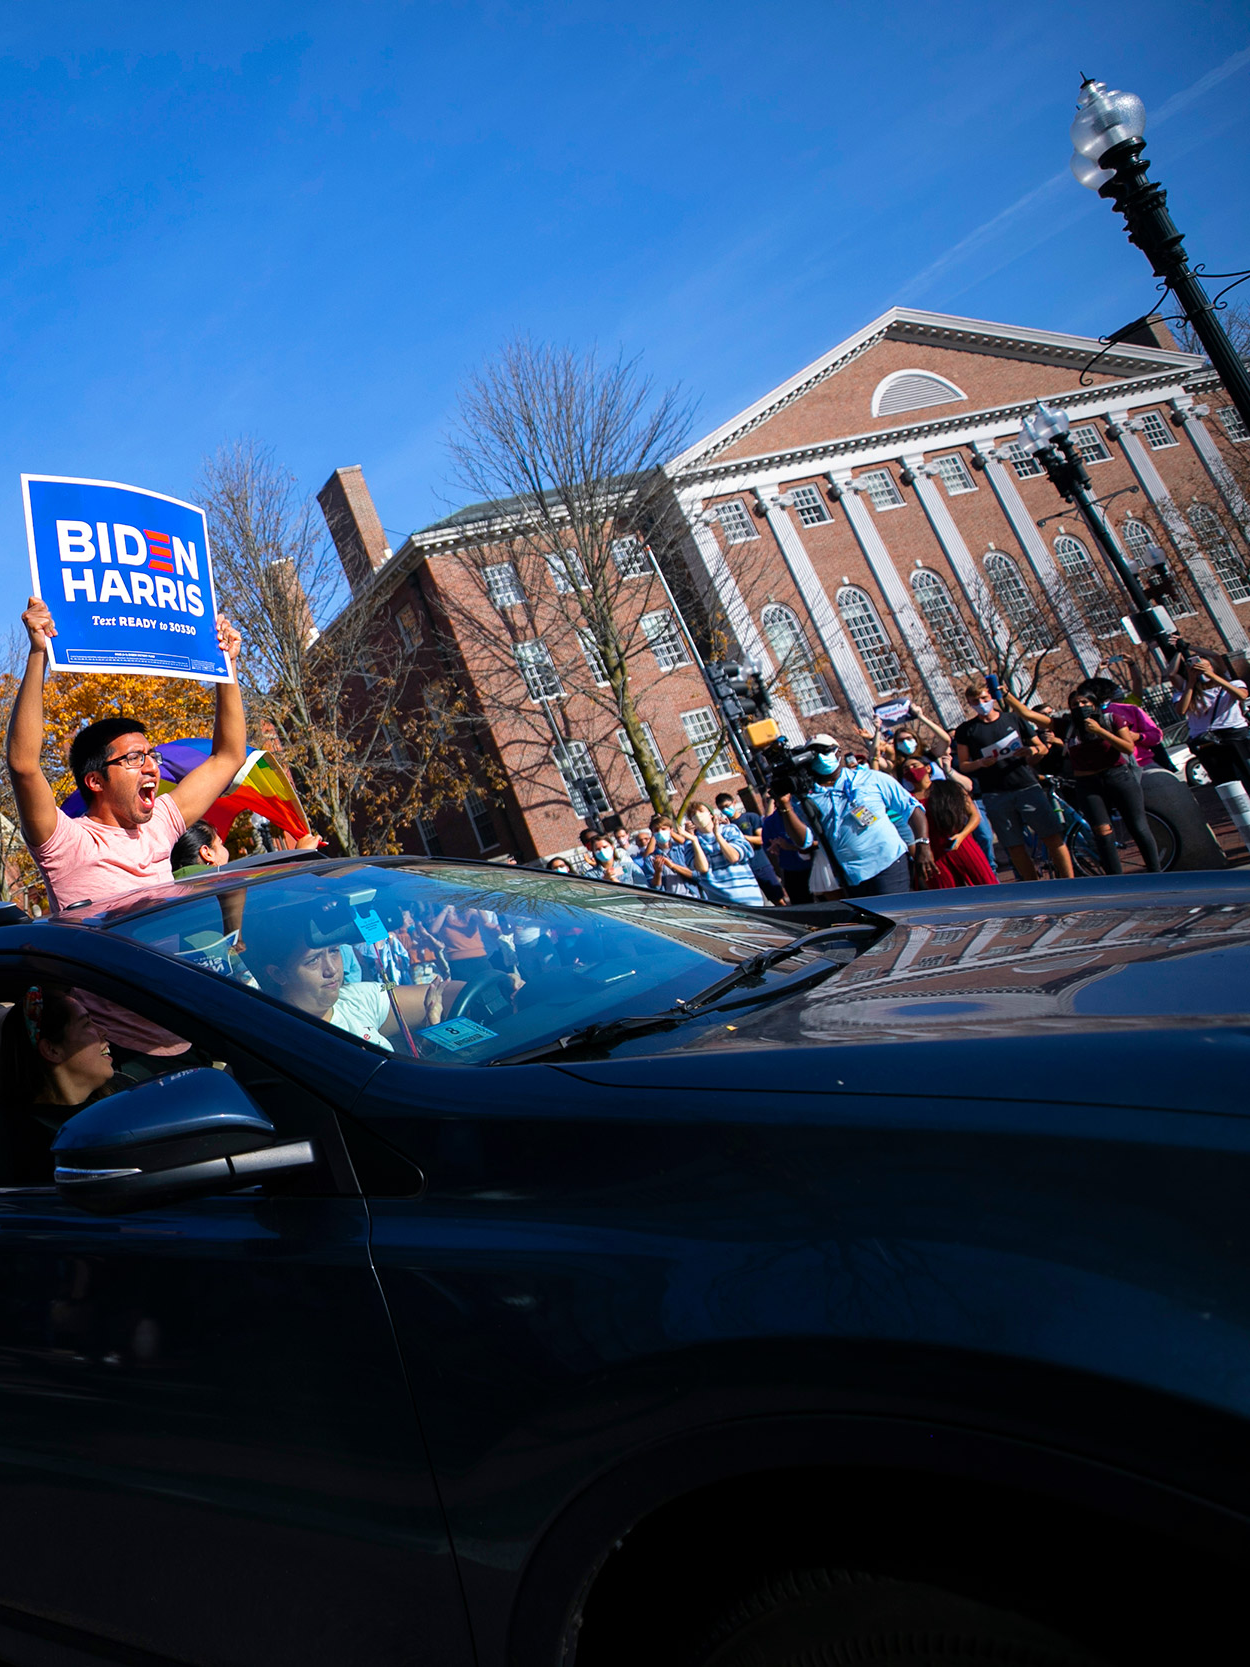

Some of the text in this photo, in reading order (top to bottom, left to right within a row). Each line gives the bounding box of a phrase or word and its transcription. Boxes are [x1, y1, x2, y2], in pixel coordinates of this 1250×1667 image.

[56, 520, 199, 580] BIDEN
[62, 568, 205, 617] HARRIS
[92, 616, 197, 636] Text READY to 30330
